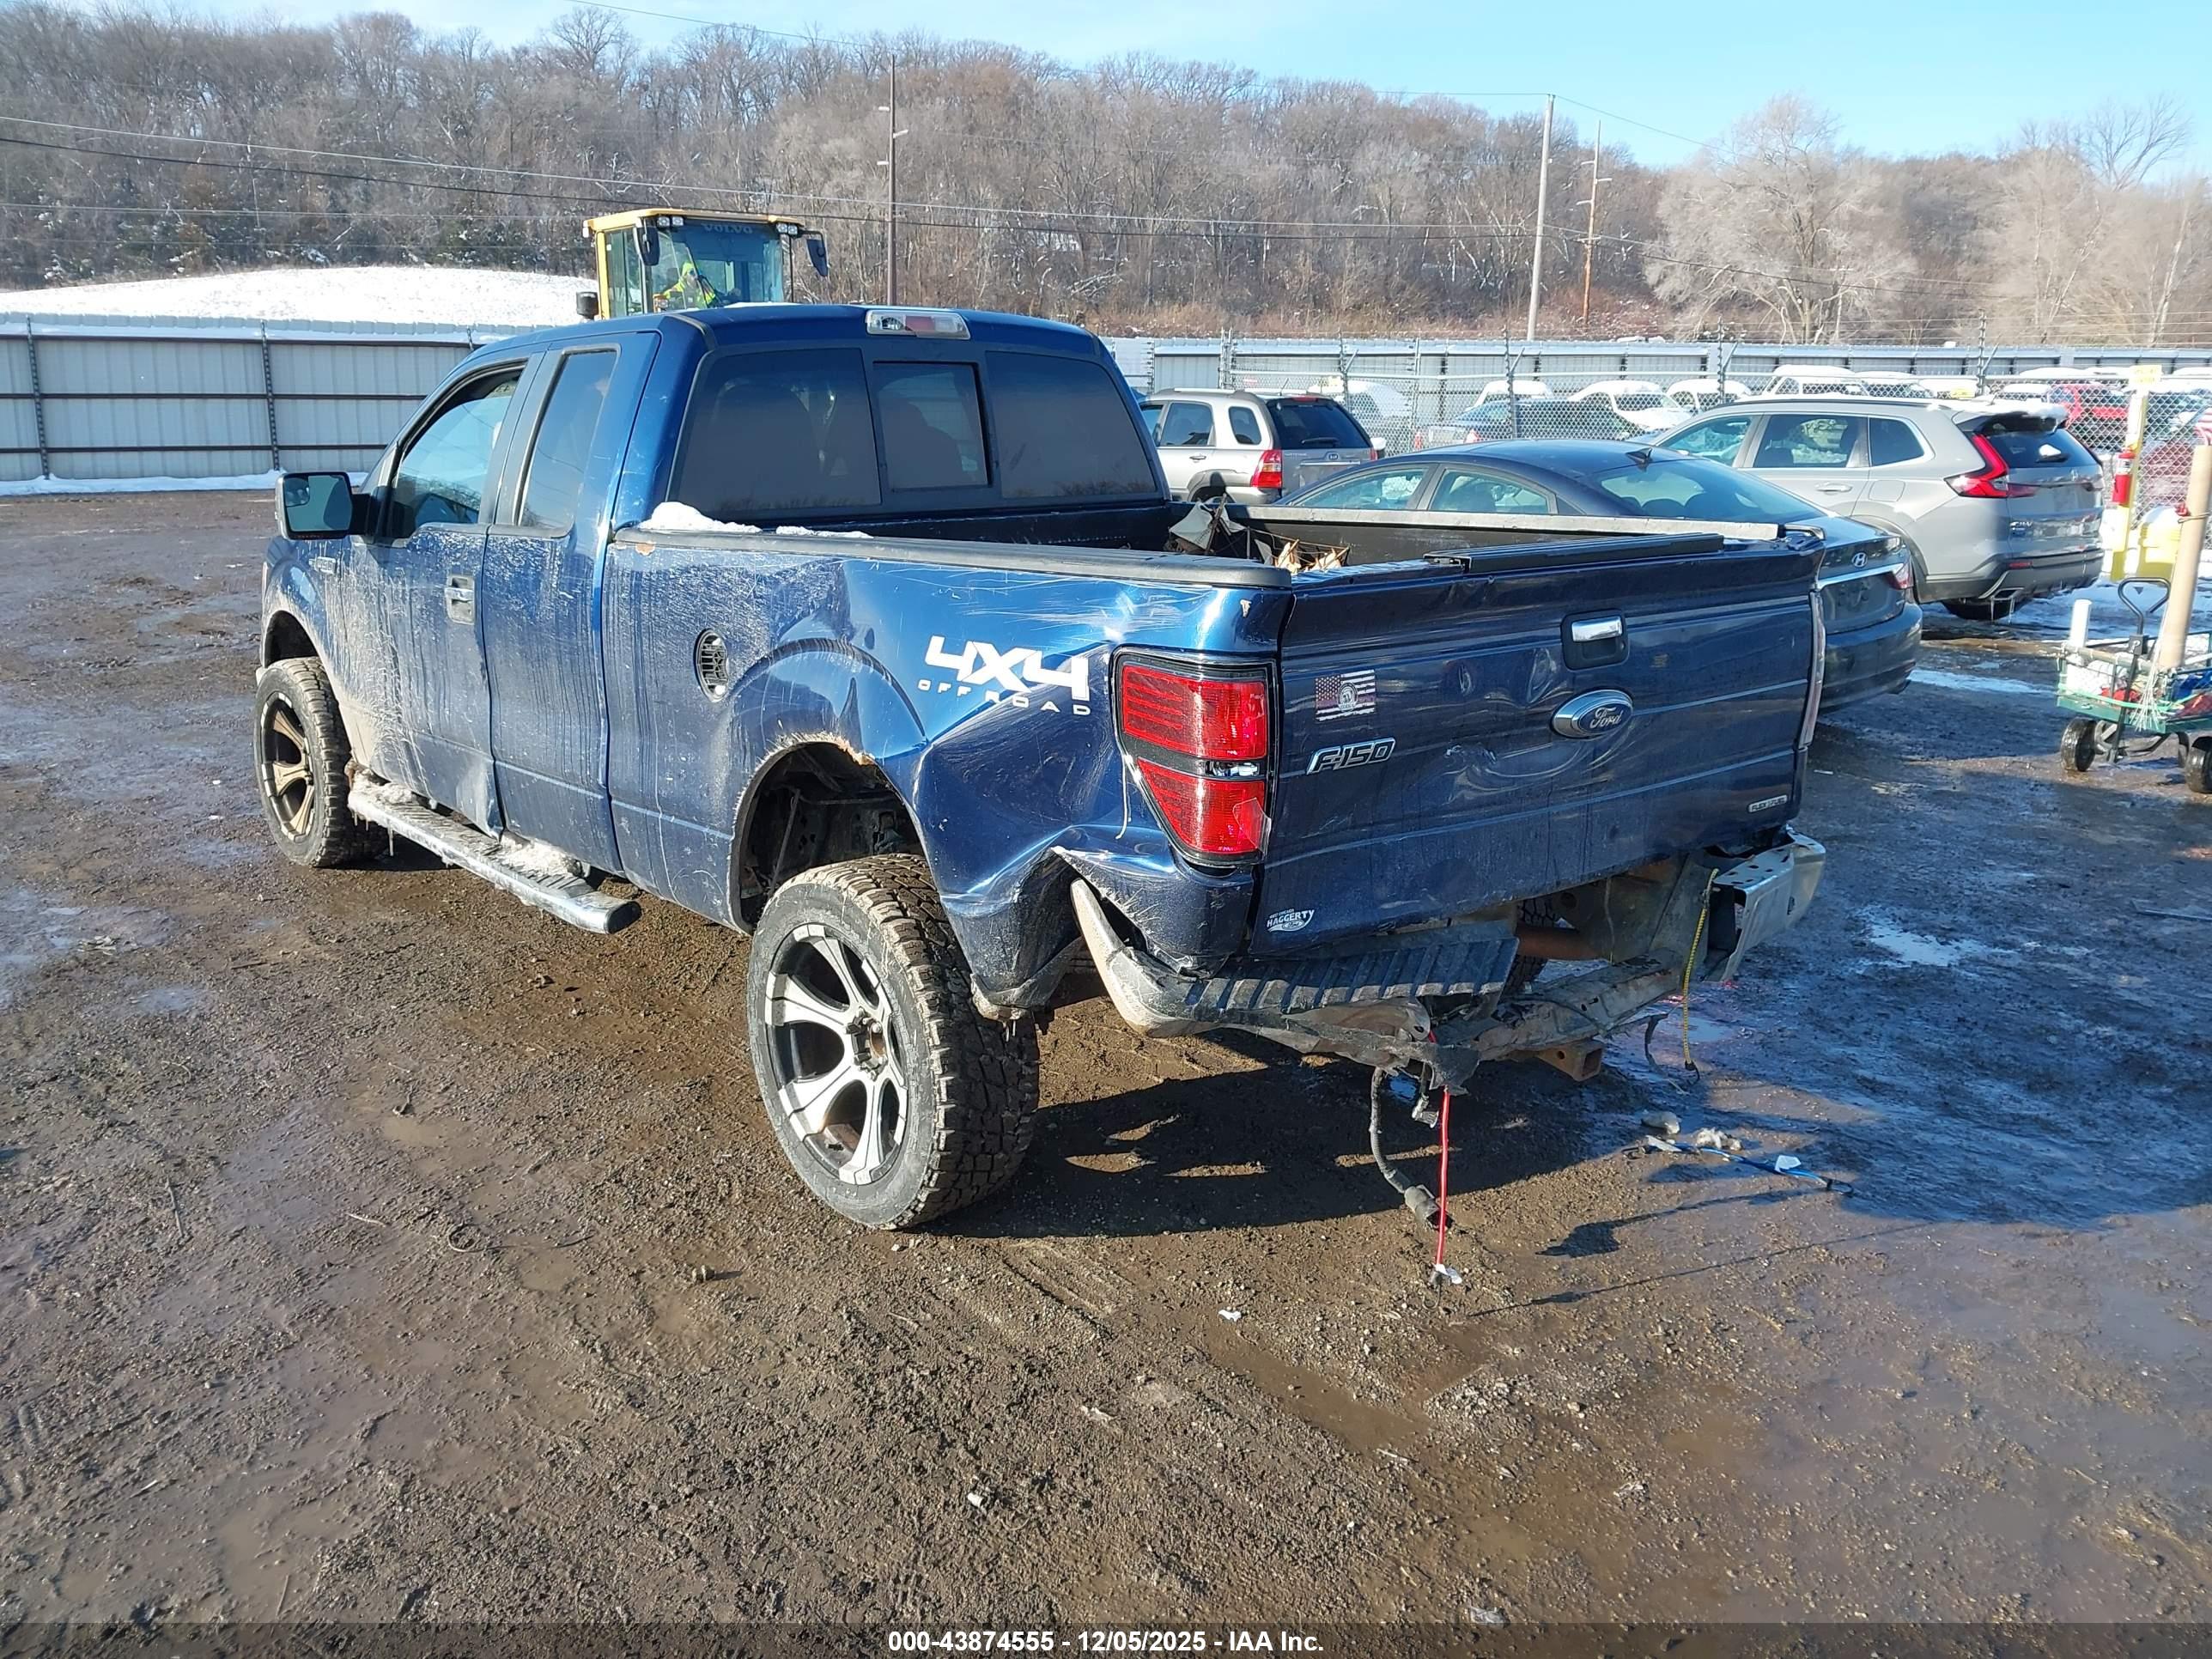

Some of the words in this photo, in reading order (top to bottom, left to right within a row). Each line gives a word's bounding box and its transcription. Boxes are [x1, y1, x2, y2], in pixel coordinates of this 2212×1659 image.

[701, 223, 753, 234] VOLVO
[917, 678, 972, 697] OFF
[985, 690, 1091, 715] ROAD
[1589, 707, 1625, 729] Ford
[1306, 737, 1396, 775] F-150
[1266, 909, 1315, 927] HAGGERTY
